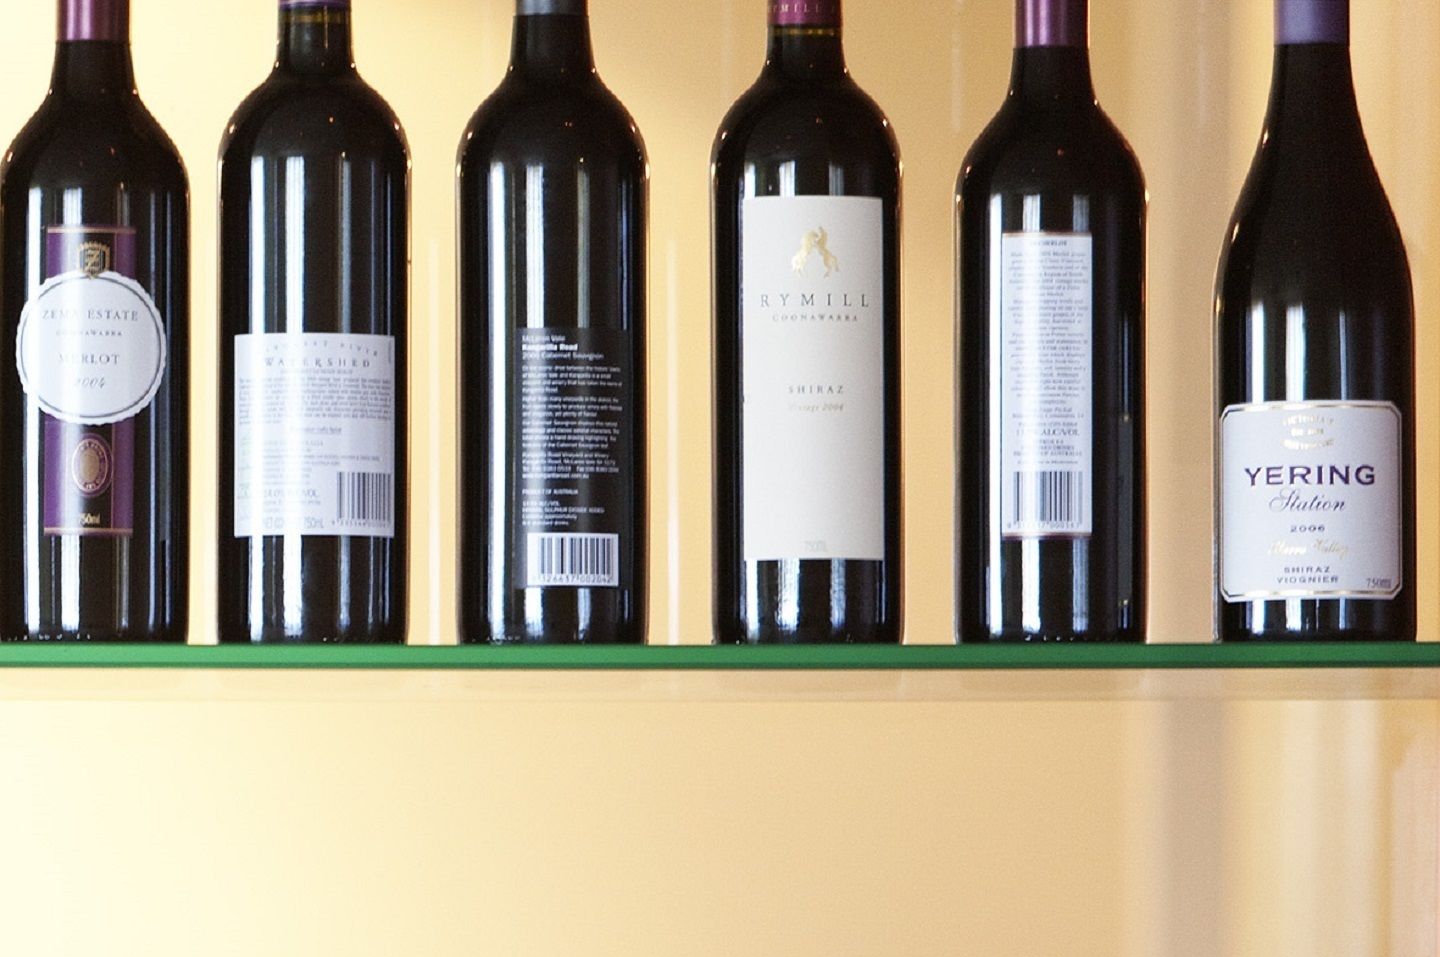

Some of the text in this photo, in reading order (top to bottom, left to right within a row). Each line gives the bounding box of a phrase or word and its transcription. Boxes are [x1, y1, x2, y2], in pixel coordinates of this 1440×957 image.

[760, 293, 869, 308] RYMILL
[87, 309, 138, 321] ESTATE
[772, 314, 858, 322] COONAWARRA
[58, 353, 121, 365] MRLOT
[264, 358, 370, 368] WAERSHED
[788, 385, 844, 394] SHIRAZ
[1244, 465, 1375, 487] YERING
[1268, 489, 1347, 512] Station
[1277, 576, 1339, 584] VIOGNIER
